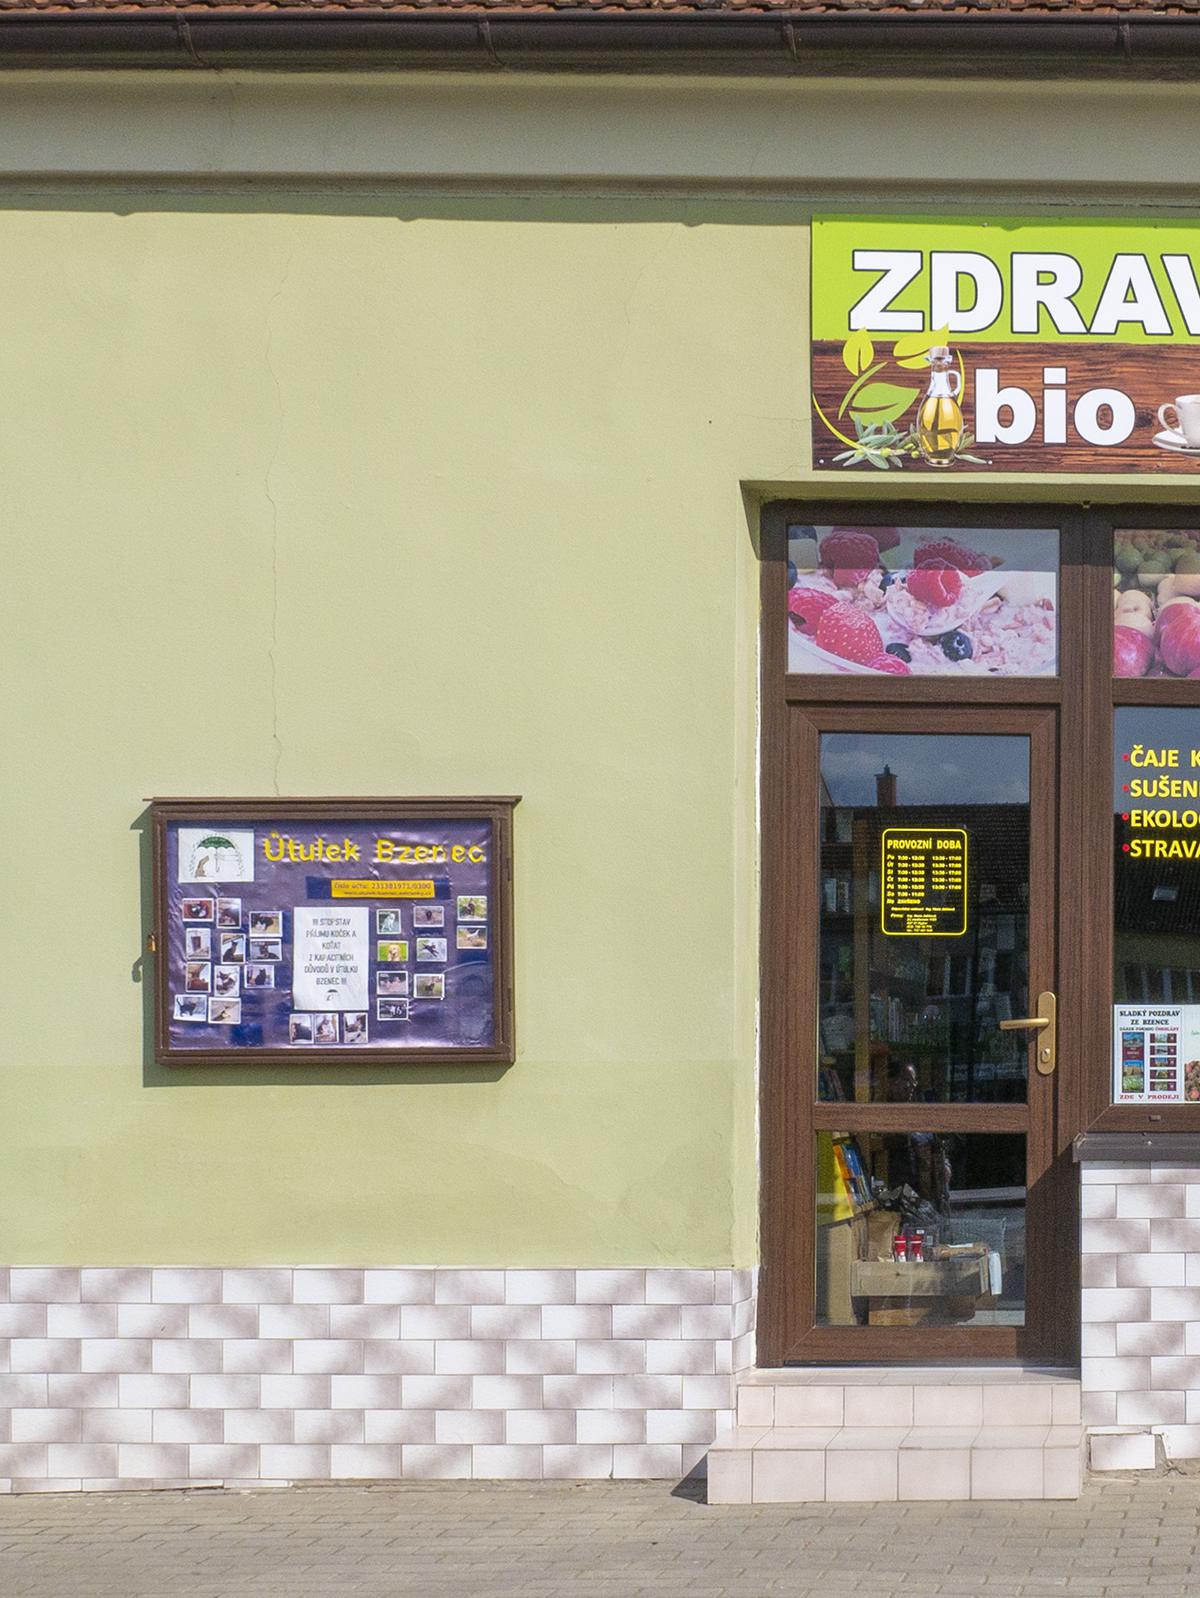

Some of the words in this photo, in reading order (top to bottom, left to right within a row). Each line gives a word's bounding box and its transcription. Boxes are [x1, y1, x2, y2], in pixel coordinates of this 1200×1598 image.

[975, 367, 1136, 446] bio
[1130, 744, 1179, 768] ČAJE
[376, 839, 484, 863] Bzenec
[886, 837, 933, 850] PROVOZNÍ
[936, 839, 962, 850] DOBA
[1120, 1009, 1147, 1017] SLADKÝ
